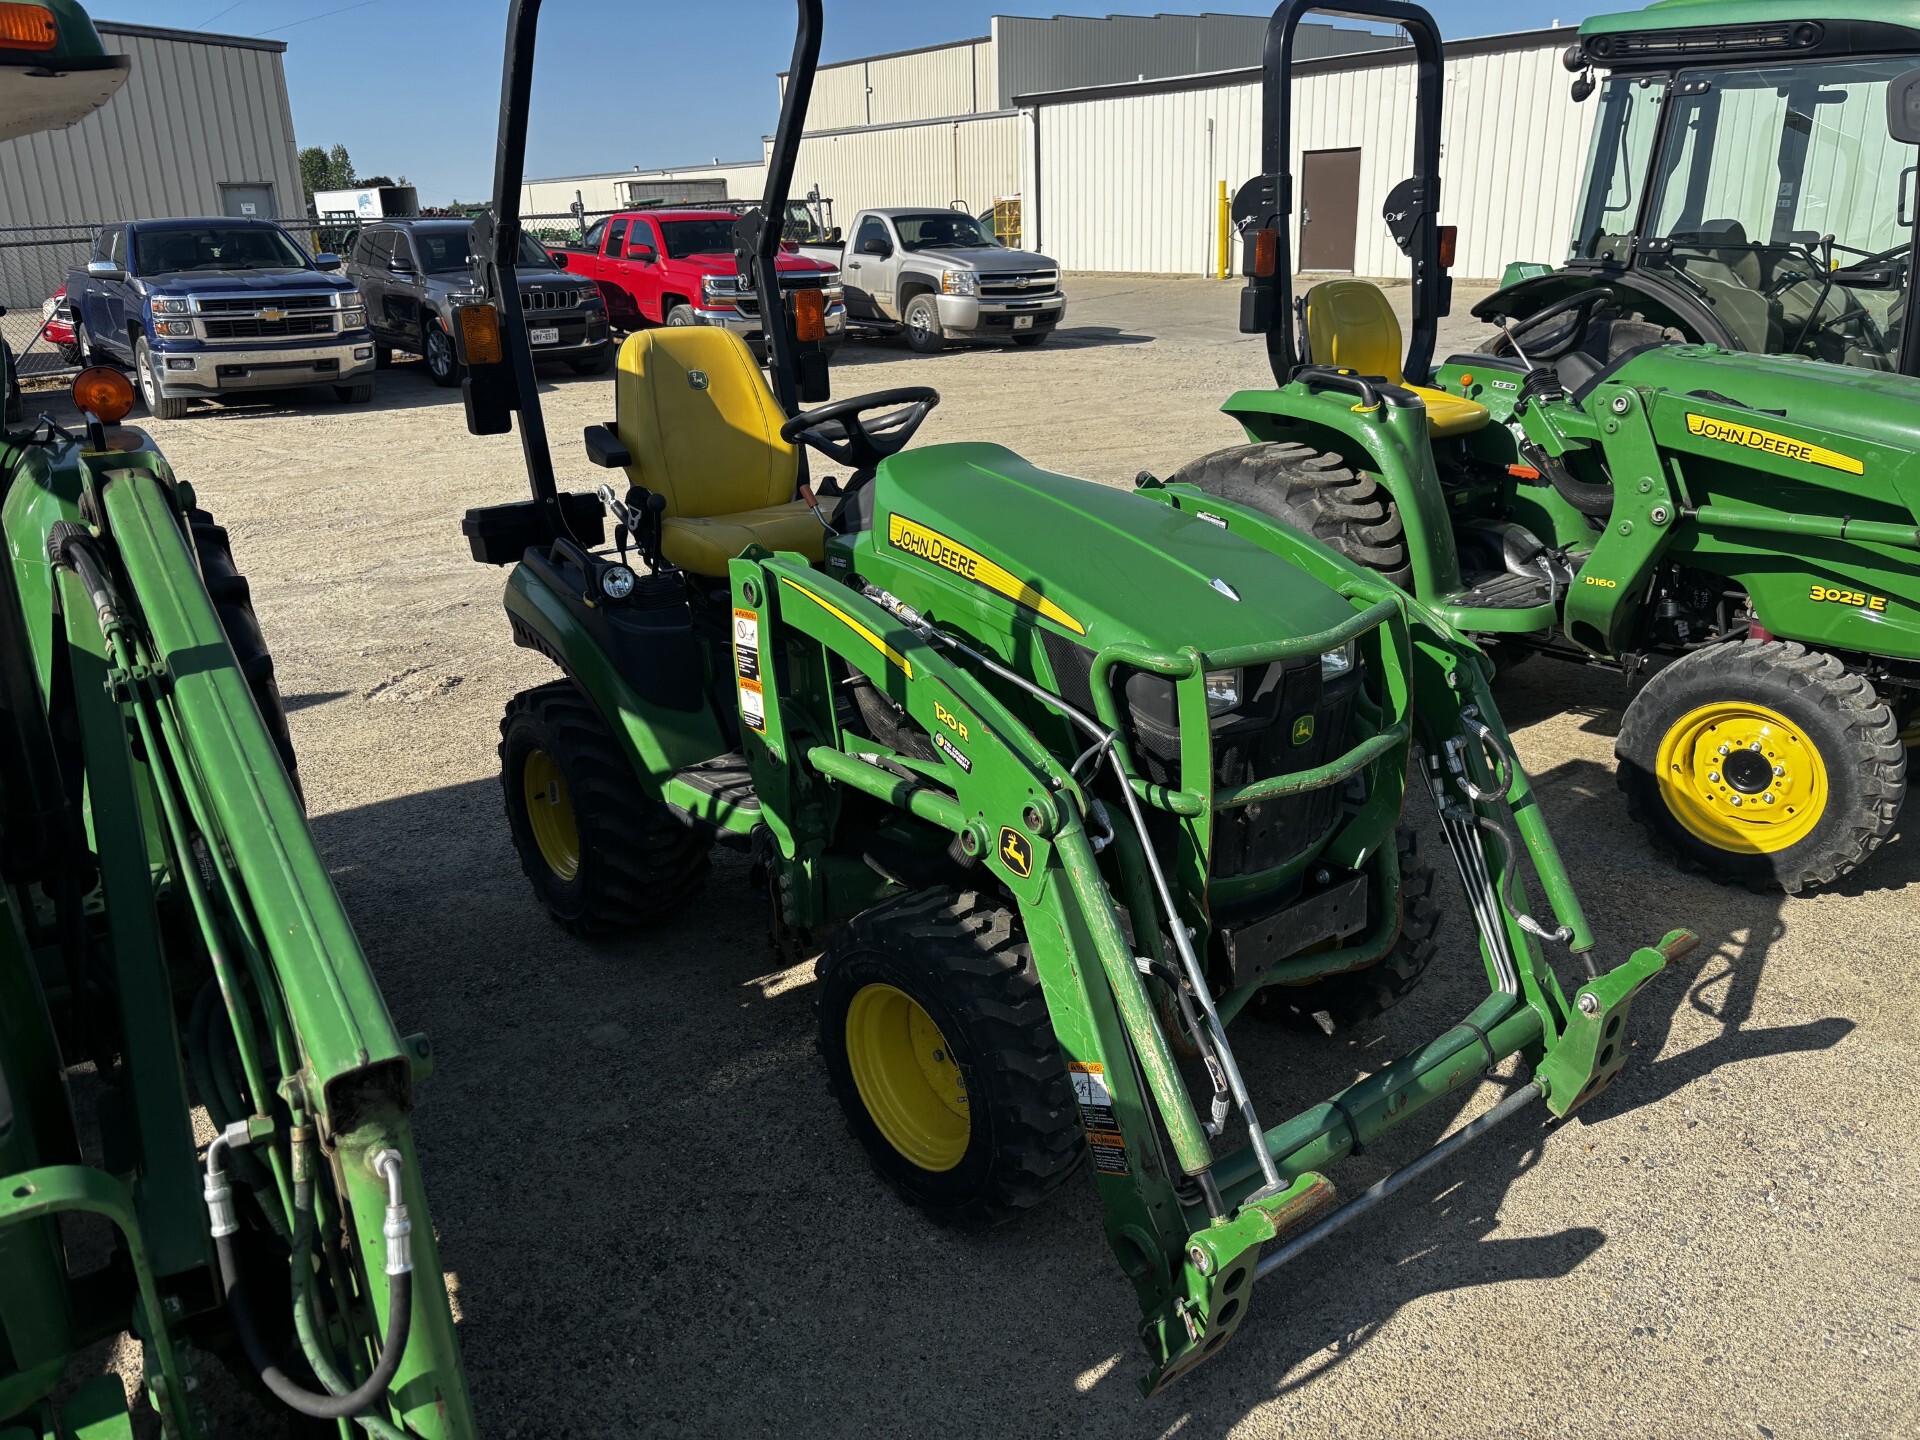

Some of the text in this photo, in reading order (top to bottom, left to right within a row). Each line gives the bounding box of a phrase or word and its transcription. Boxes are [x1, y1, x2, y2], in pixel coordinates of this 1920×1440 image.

[1693, 419, 1813, 460] JOHN DEERE
[895, 525, 978, 578] JOHN DEERE
[1586, 576, 1617, 588] D160
[1809, 585, 1887, 611] 3025 E
[934, 700, 970, 743] 120 R
